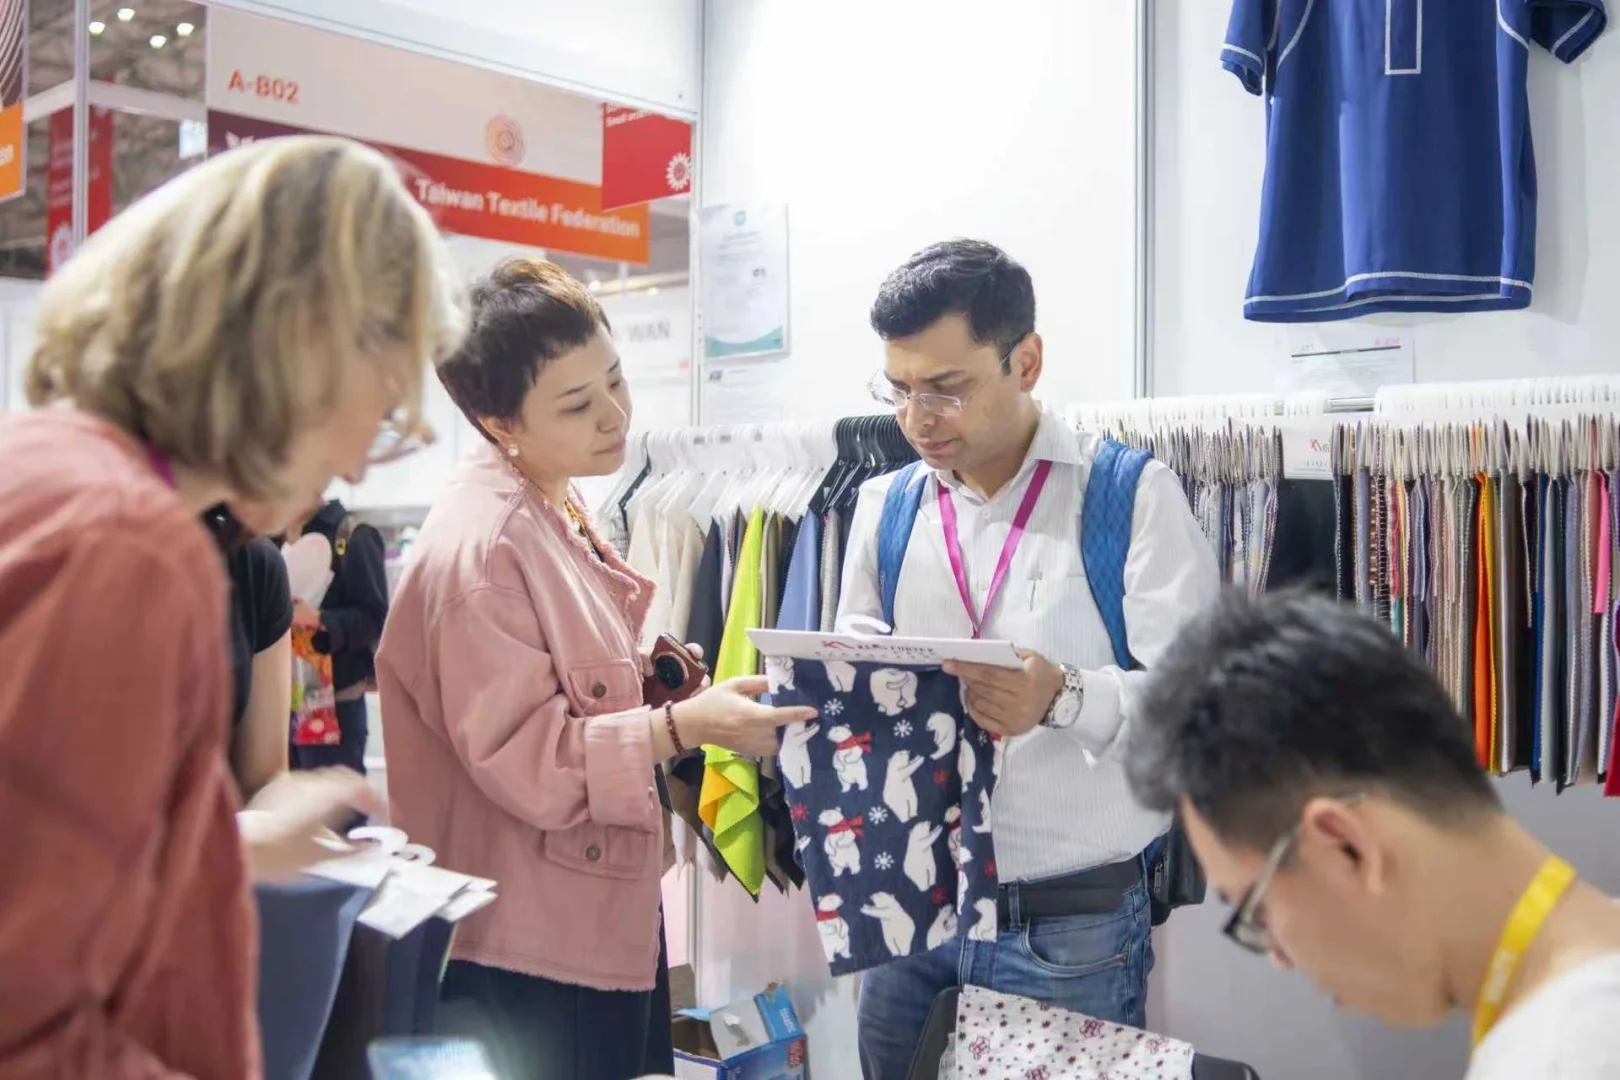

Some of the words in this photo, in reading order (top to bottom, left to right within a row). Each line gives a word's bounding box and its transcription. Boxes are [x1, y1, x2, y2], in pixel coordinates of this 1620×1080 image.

[227, 69, 299, 103] A-B02
[415, 177, 484, 211] Taiwan
[486, 190, 548, 223] Textile
[550, 203, 640, 238] Federation
